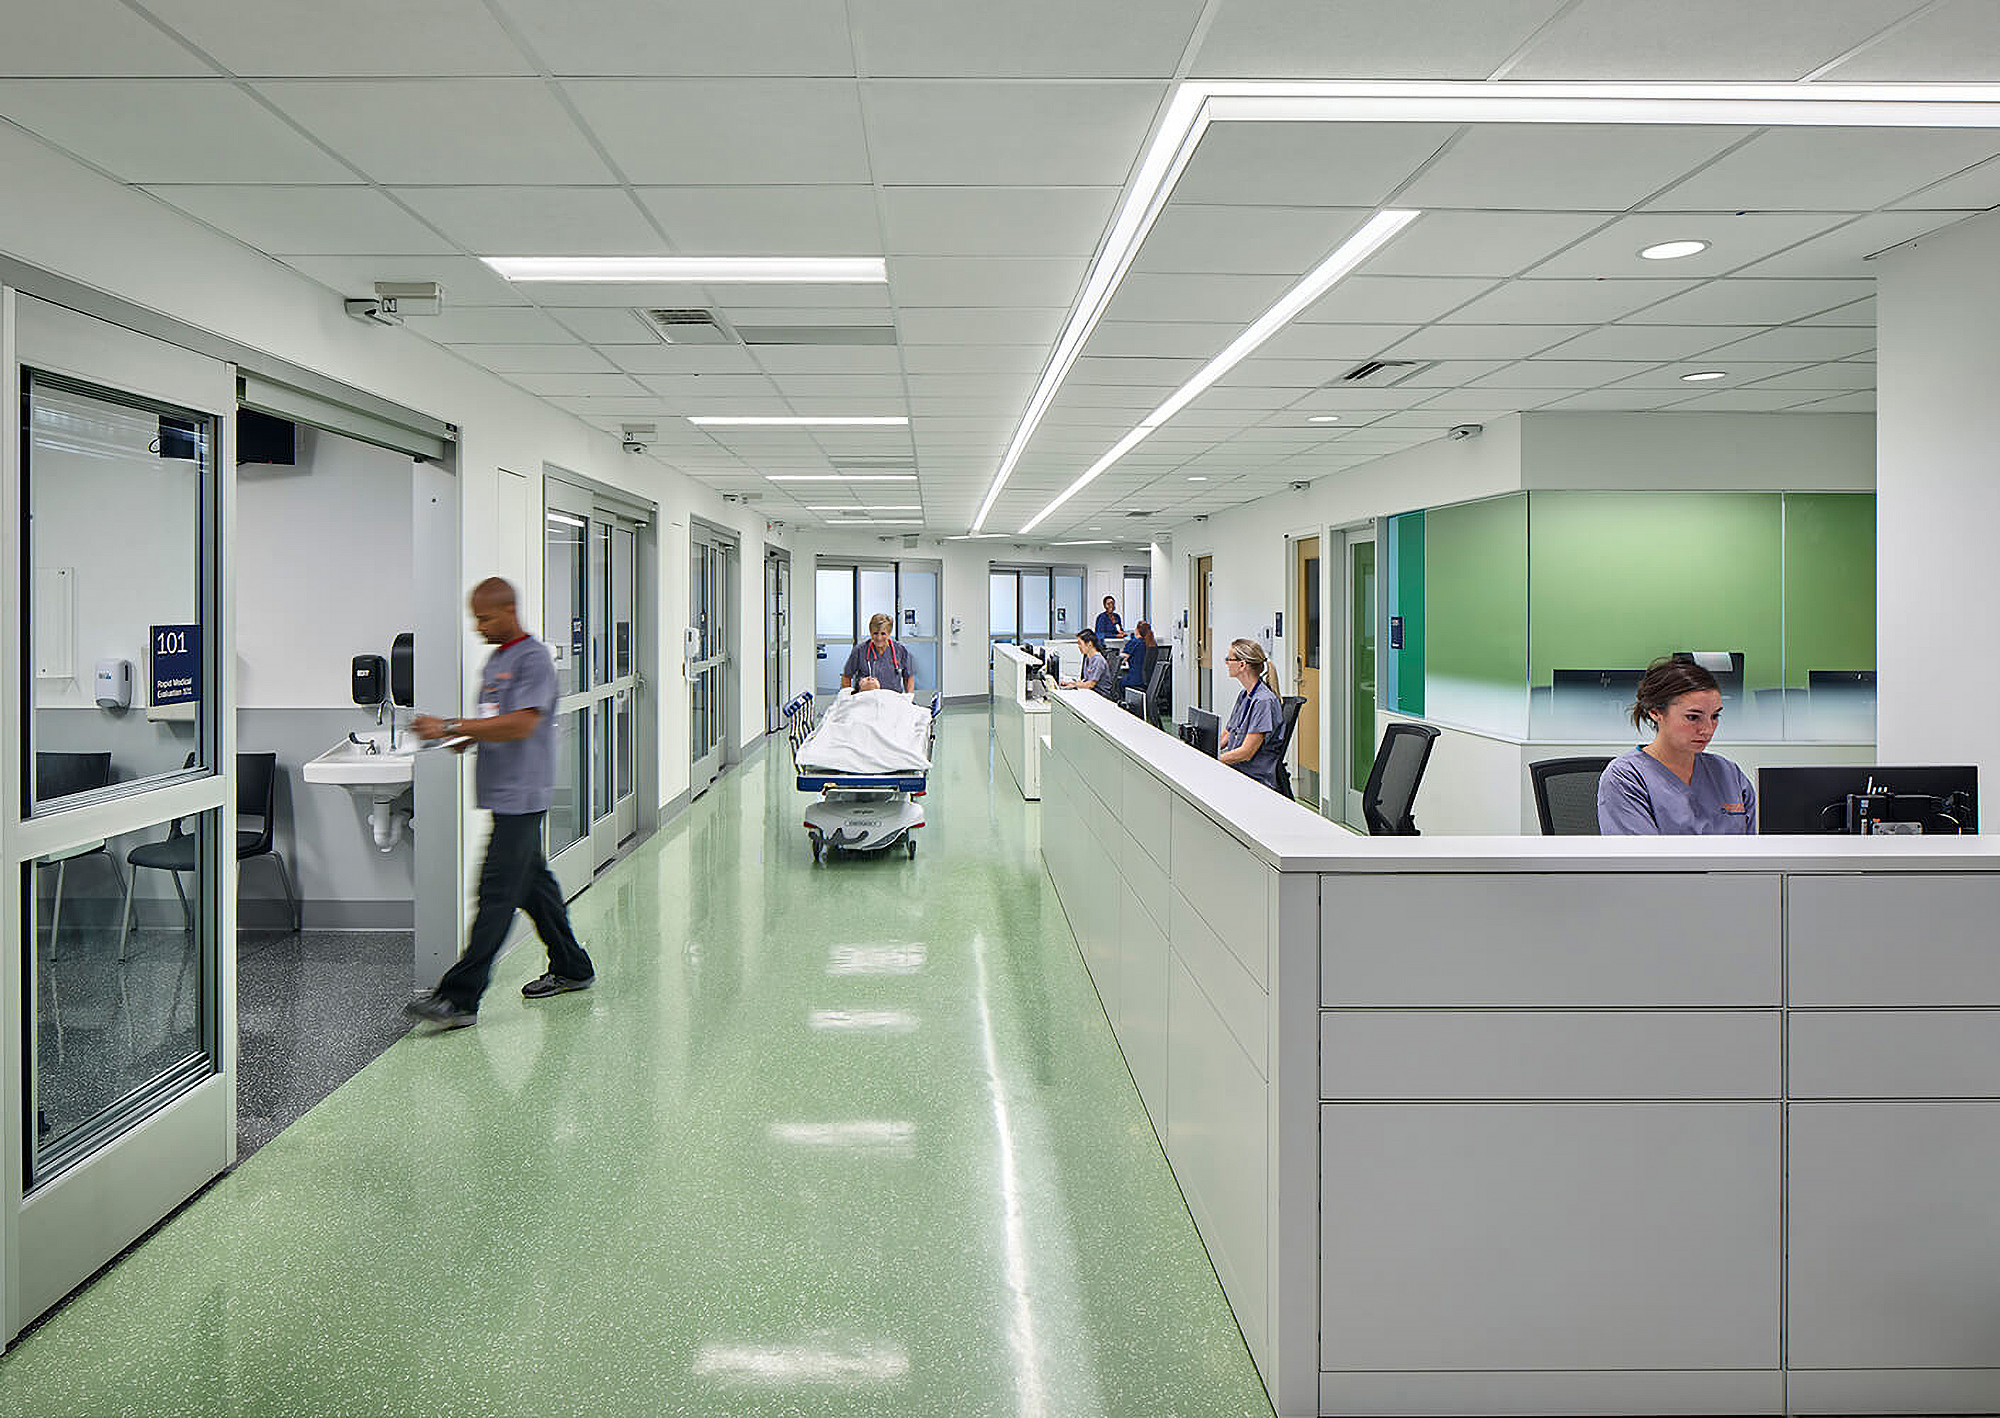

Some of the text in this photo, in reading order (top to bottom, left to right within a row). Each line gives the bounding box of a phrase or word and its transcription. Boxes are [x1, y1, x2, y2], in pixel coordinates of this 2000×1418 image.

[158, 632, 188, 654] 101
[157, 677, 193, 688] Rapid Medical
